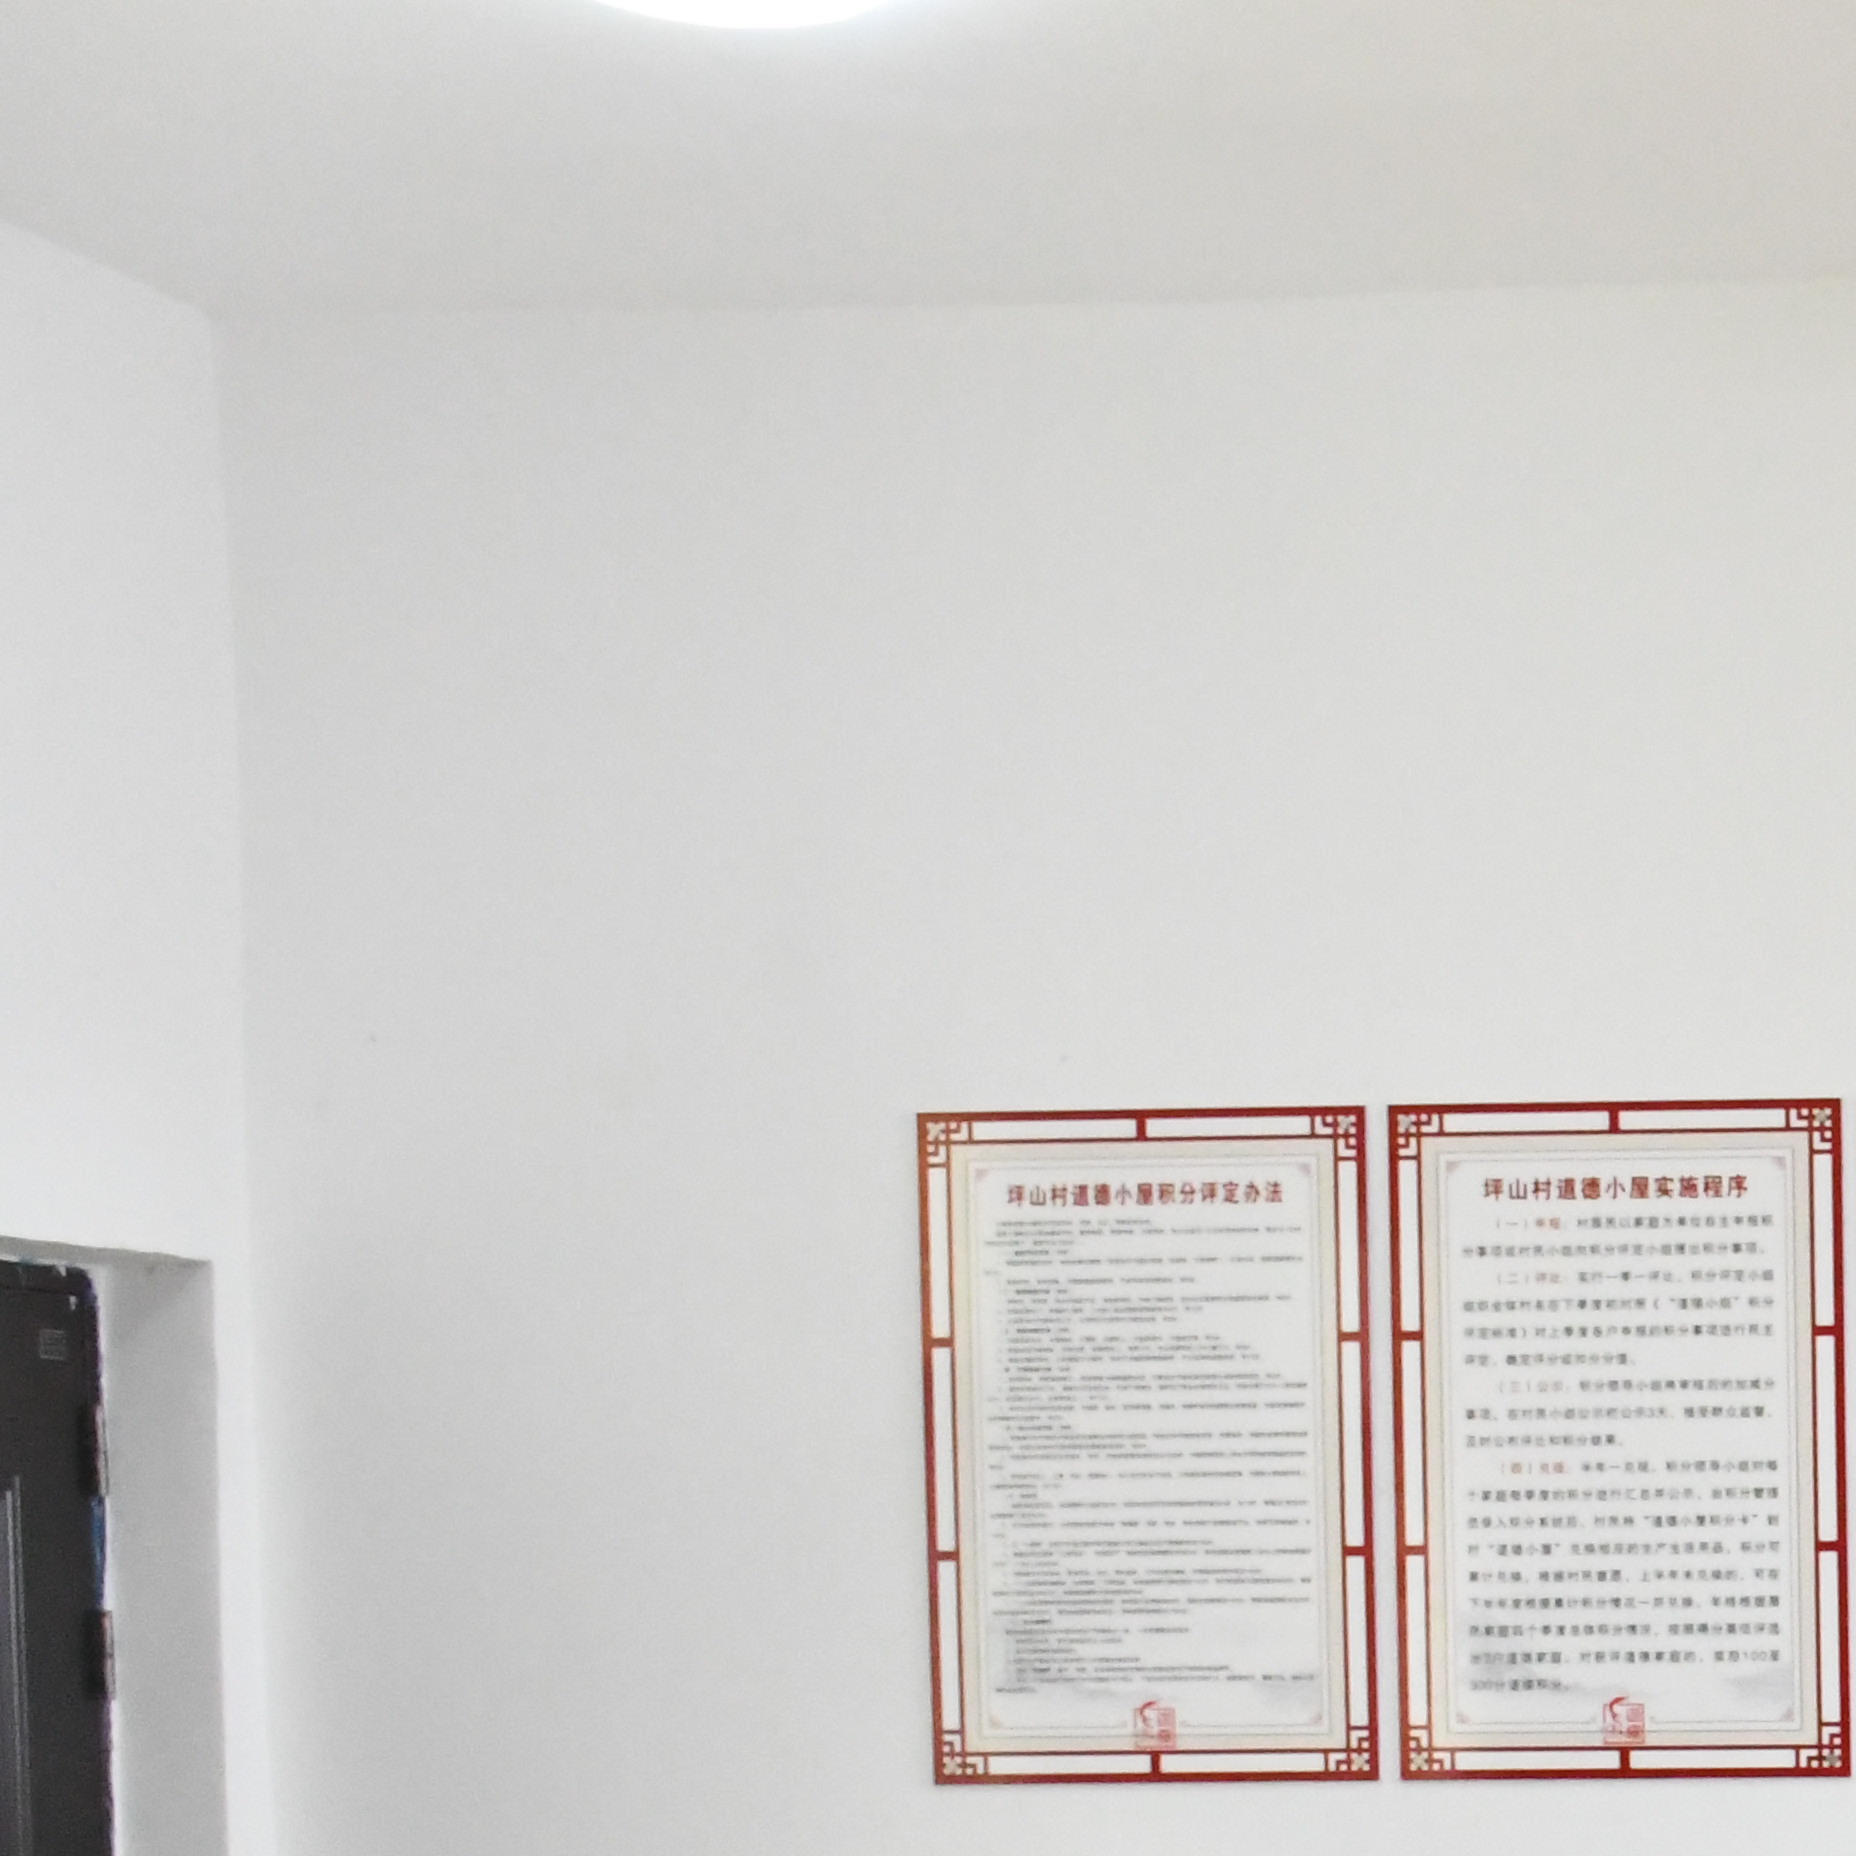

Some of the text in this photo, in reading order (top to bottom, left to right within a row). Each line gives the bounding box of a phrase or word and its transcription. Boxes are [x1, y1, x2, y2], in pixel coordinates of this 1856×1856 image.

[1007, 1182, 1283, 1207] 坪山村道德小屋积分评定办法
[1483, 1174, 1749, 1200] 坪山村道德小屋实施程序
